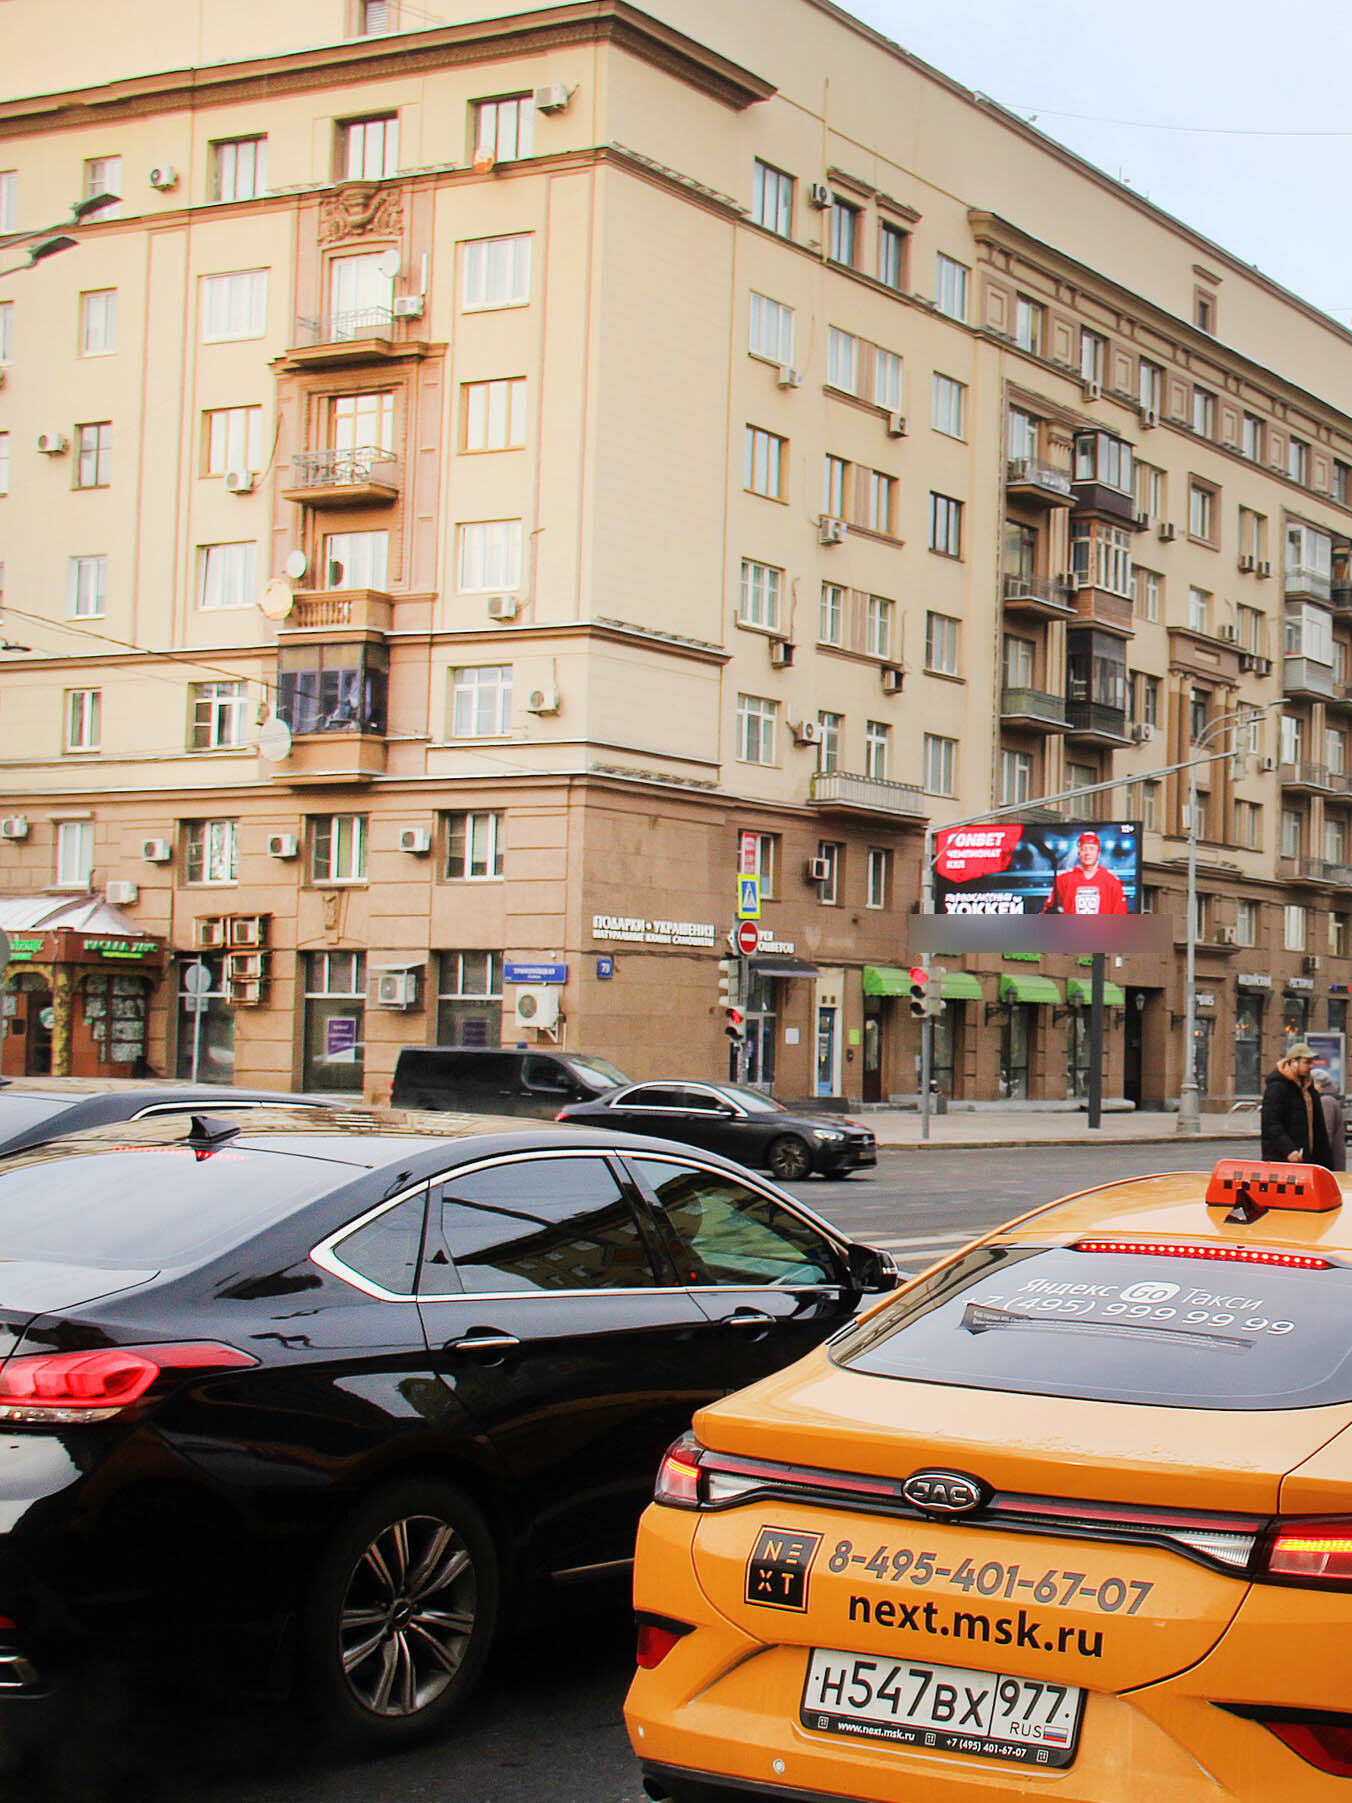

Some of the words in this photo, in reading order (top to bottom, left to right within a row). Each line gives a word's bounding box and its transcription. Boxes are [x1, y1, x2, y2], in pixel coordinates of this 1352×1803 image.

[592, 914, 646, 932] ПОДАРКИ
[652, 919, 715, 936] УКРАШЕНИЯ
[1017, 1278, 1121, 1299] Яндекс
[1131, 1284, 1170, 1301] Go
[1182, 1287, 1264, 1311] Такси
[1003, 1296, 1096, 1317] (495)
[1101, 1302, 1177, 1320] 999
[1181, 1310, 1235, 1328] 99
[1240, 1317, 1296, 1336] 99
[912, 1482, 968, 1503] JAC
[828, 1540, 1154, 1615] 8-495-401-67-07
[849, 1594, 1104, 1658] next.msk.ru
[999, 1679, 1068, 1724] 977
[837, 1721, 916, 1742] www.next.msk.ru
[1009, 1721, 1042, 1739] RUS
[946, 1737, 958, 1748] +7
[959, 1738, 982, 1753] (495)
[983, 1742, 1027, 1758] 401-67-07
